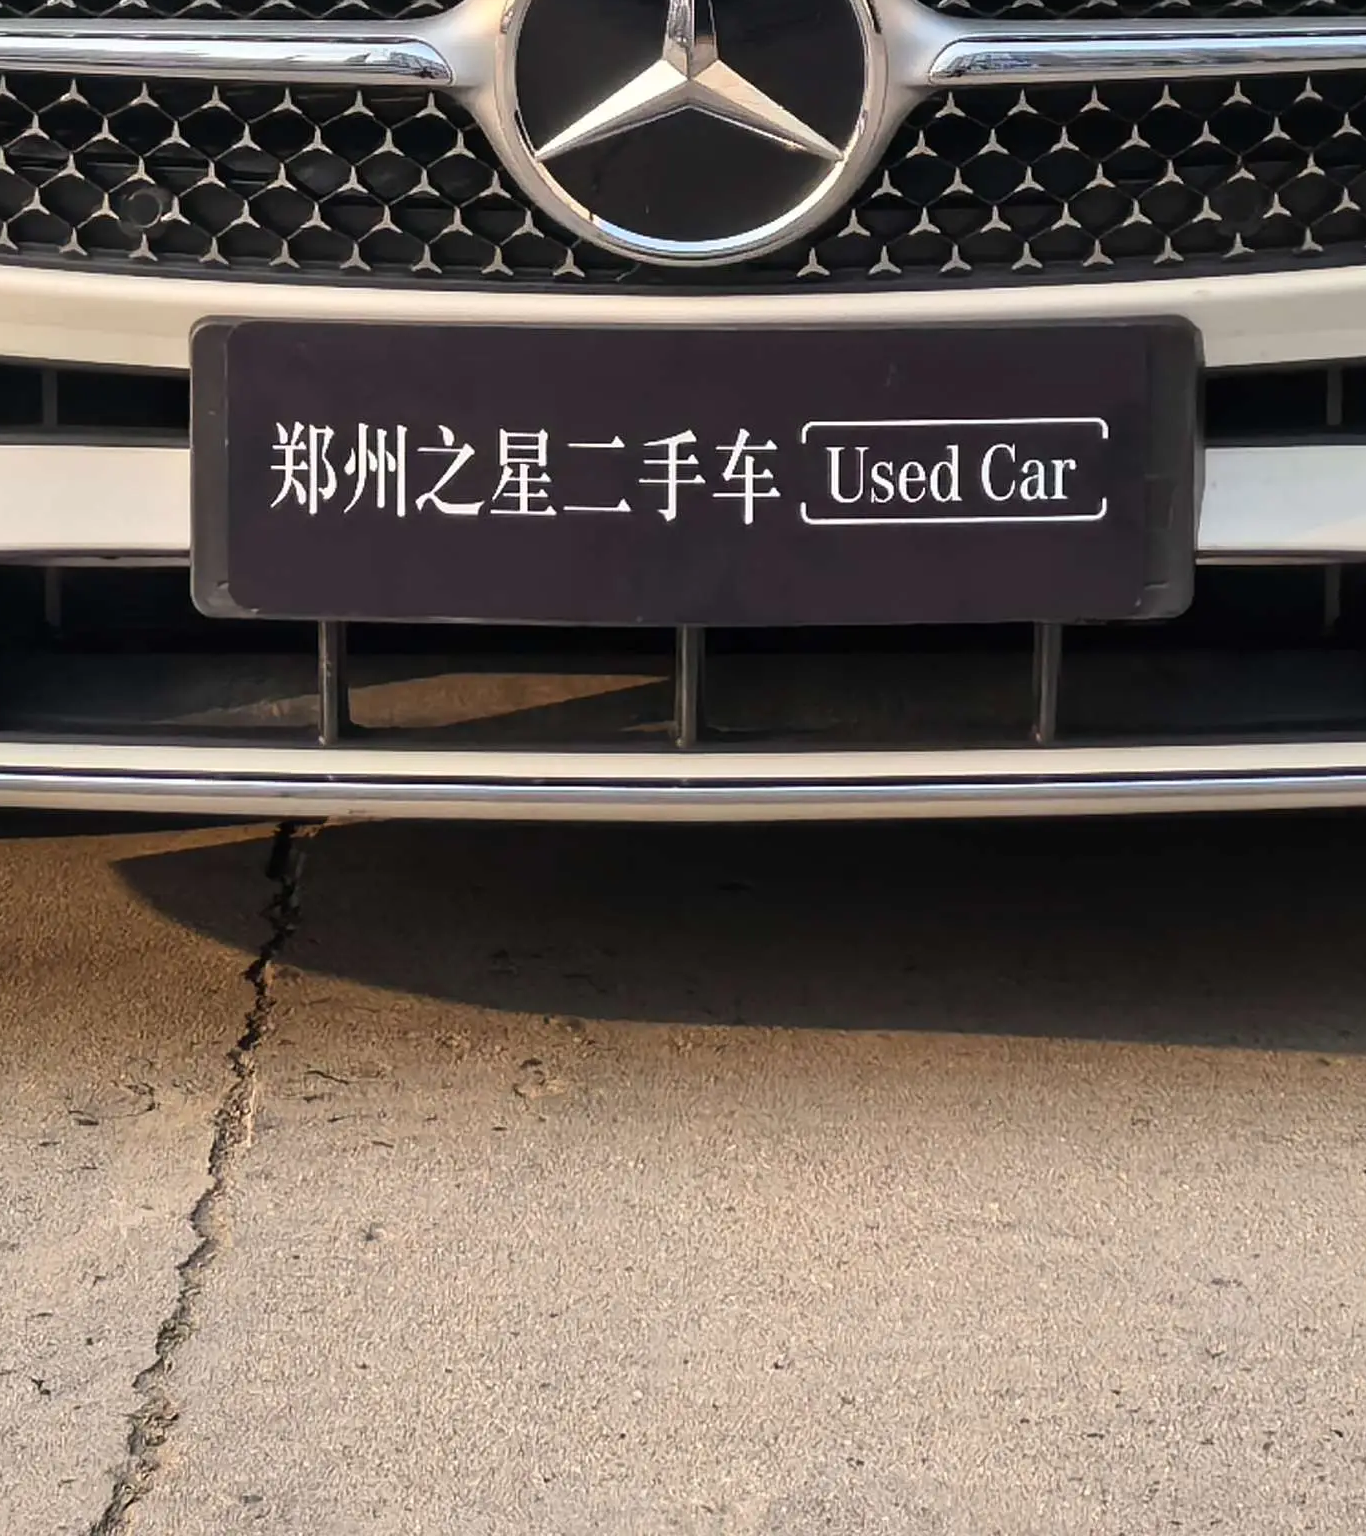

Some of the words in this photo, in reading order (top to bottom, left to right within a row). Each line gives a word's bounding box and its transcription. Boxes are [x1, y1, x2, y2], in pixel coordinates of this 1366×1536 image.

[269, 422, 781, 525] 郑州之星二手车
[826, 443, 963, 504] Used
[980, 439, 1078, 503] Car
